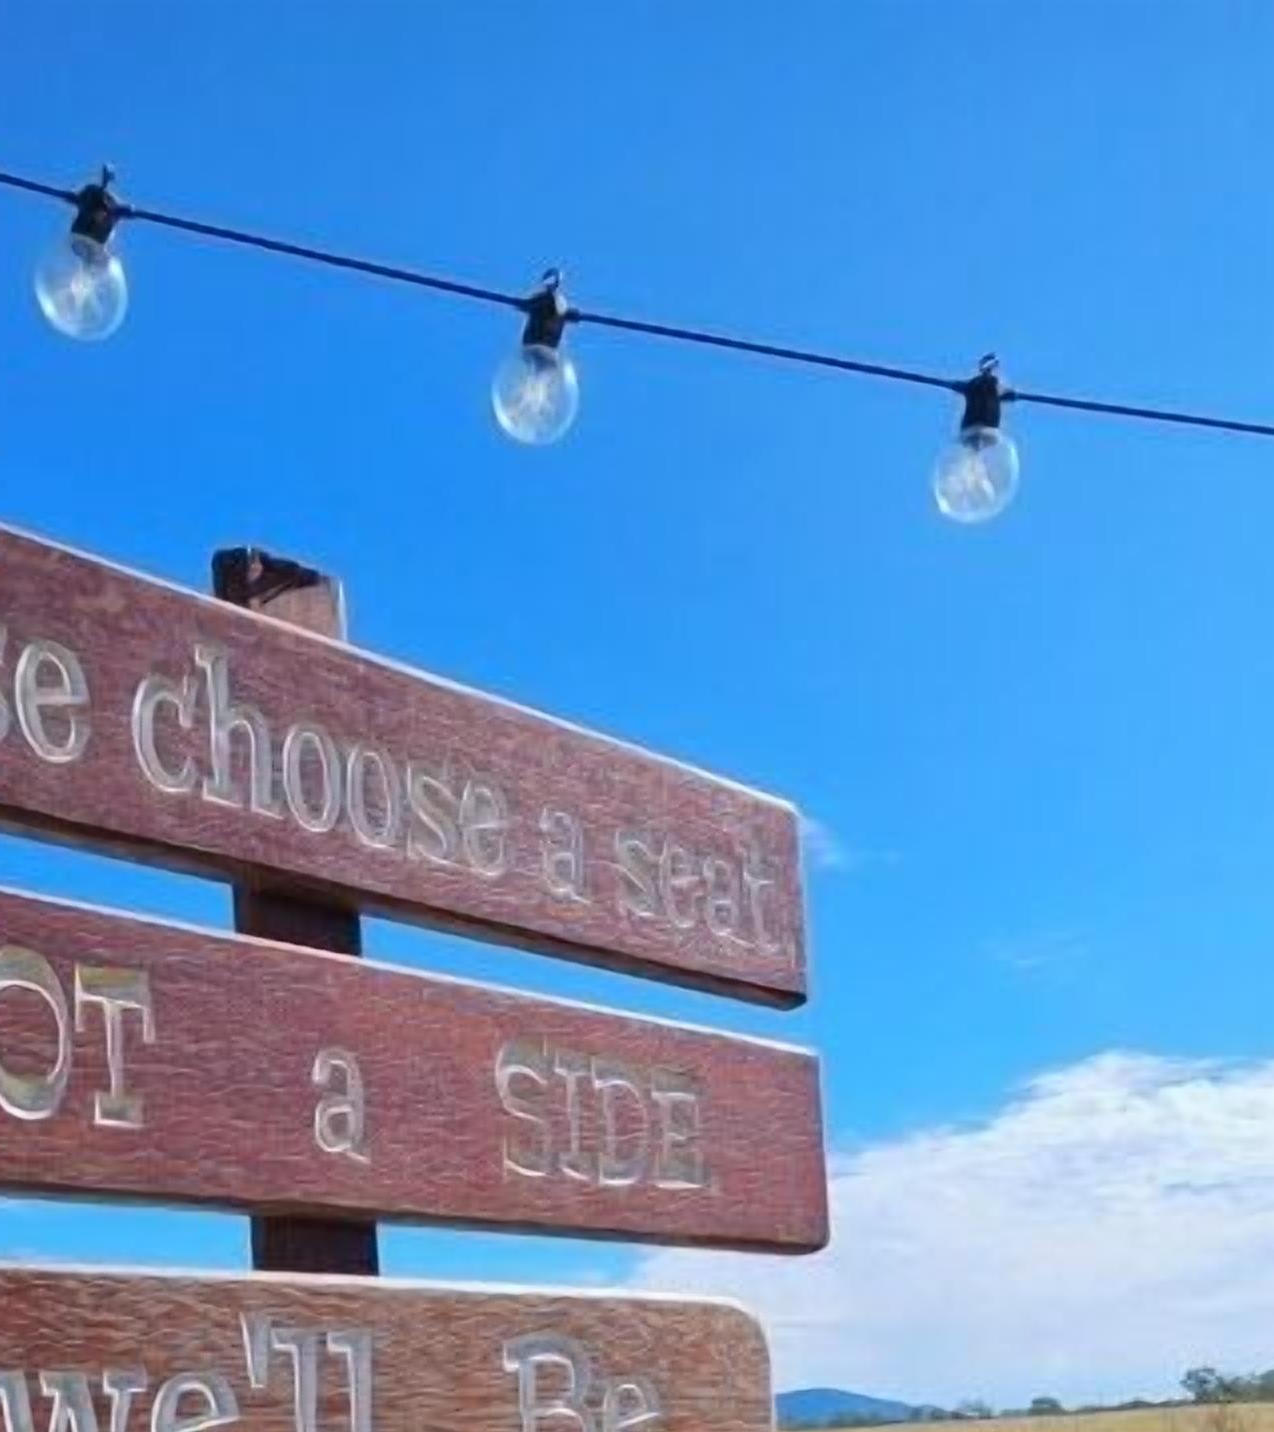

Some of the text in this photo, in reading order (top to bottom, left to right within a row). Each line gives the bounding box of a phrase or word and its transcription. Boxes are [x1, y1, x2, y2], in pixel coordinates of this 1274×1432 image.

[132, 641, 515, 878] choose
[540, 806, 590, 904] a
[613, 827, 782, 955] seat
[311, 1046, 371, 1162] a
[494, 1040, 710, 1190] SIDE
